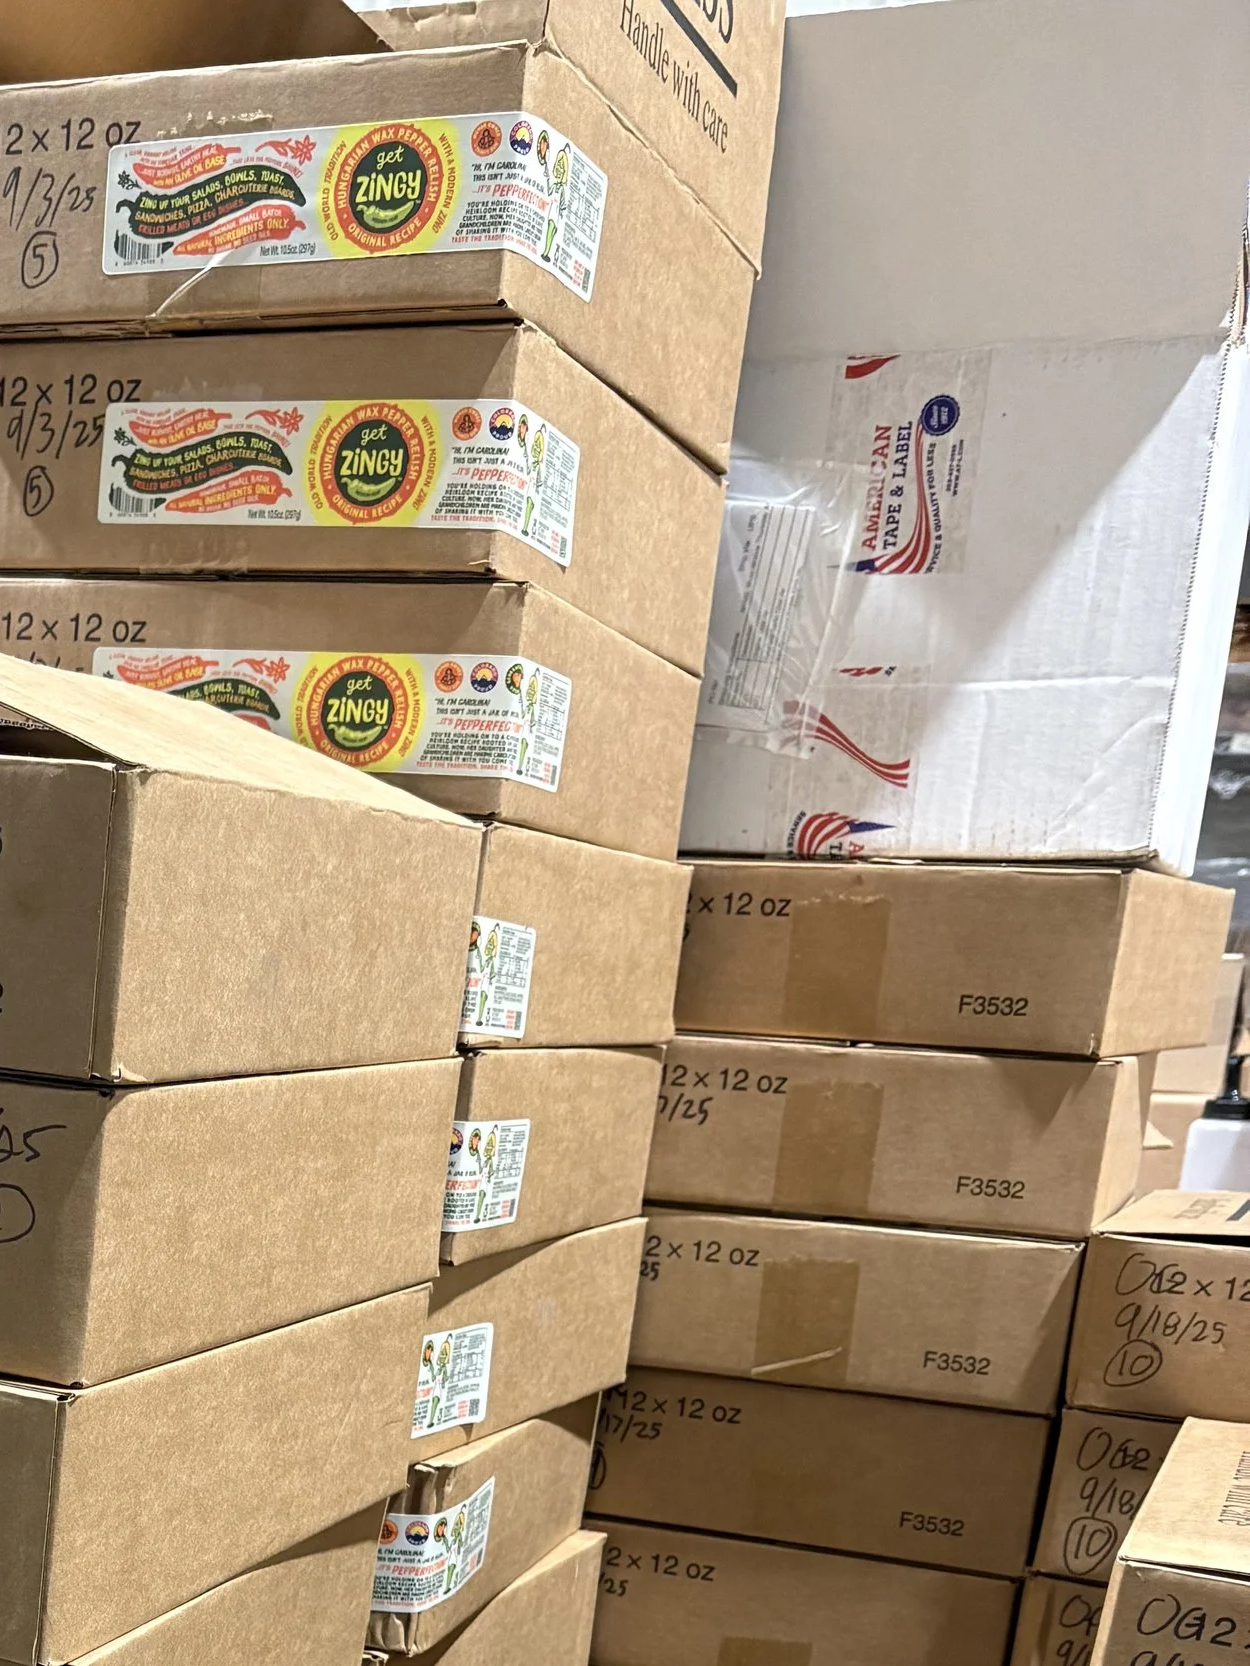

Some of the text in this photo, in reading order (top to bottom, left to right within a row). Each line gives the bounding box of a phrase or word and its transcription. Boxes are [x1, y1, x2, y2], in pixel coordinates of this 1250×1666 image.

[620, 0, 728, 153] Handle with care
[32, 128, 49, 152] x
[62, 118, 95, 151] 12
[106, 121, 141, 148] oz
[439, 133, 453, 156] WITH
[204, 154, 227, 169] BASE
[337, 128, 439, 208] HUNGARIAN WAX PEPPER RELISH
[377, 145, 404, 170] get
[170, 195, 190, 210] YOUR
[224, 170, 257, 186] BOWLS,
[187, 199, 212, 217] PIZZA,
[214, 183, 268, 204] CHARCUTERIE
[322, 187, 330, 222] WORLD
[348, 217, 422, 247] ORIGINAL RECIPE
[36, 384, 53, 404] x
[64, 374, 97, 404] 12
[107, 379, 142, 403] oz
[361, 424, 387, 446] get
[862, 424, 893, 551] AMERICAN
[883, 420, 912, 550] TAPE & LABEL
[1, 612, 147, 643] 12 x 12 oz
[347, 676, 372, 697] get
[699, 893, 792, 918] x 12 oz
[958, 995, 1029, 1017] F3532
[692, 1071, 709, 1088] x
[719, 1069, 748, 1091] 12
[757, 1073, 788, 1095] oz
[956, 1176, 1026, 1200] F3532
